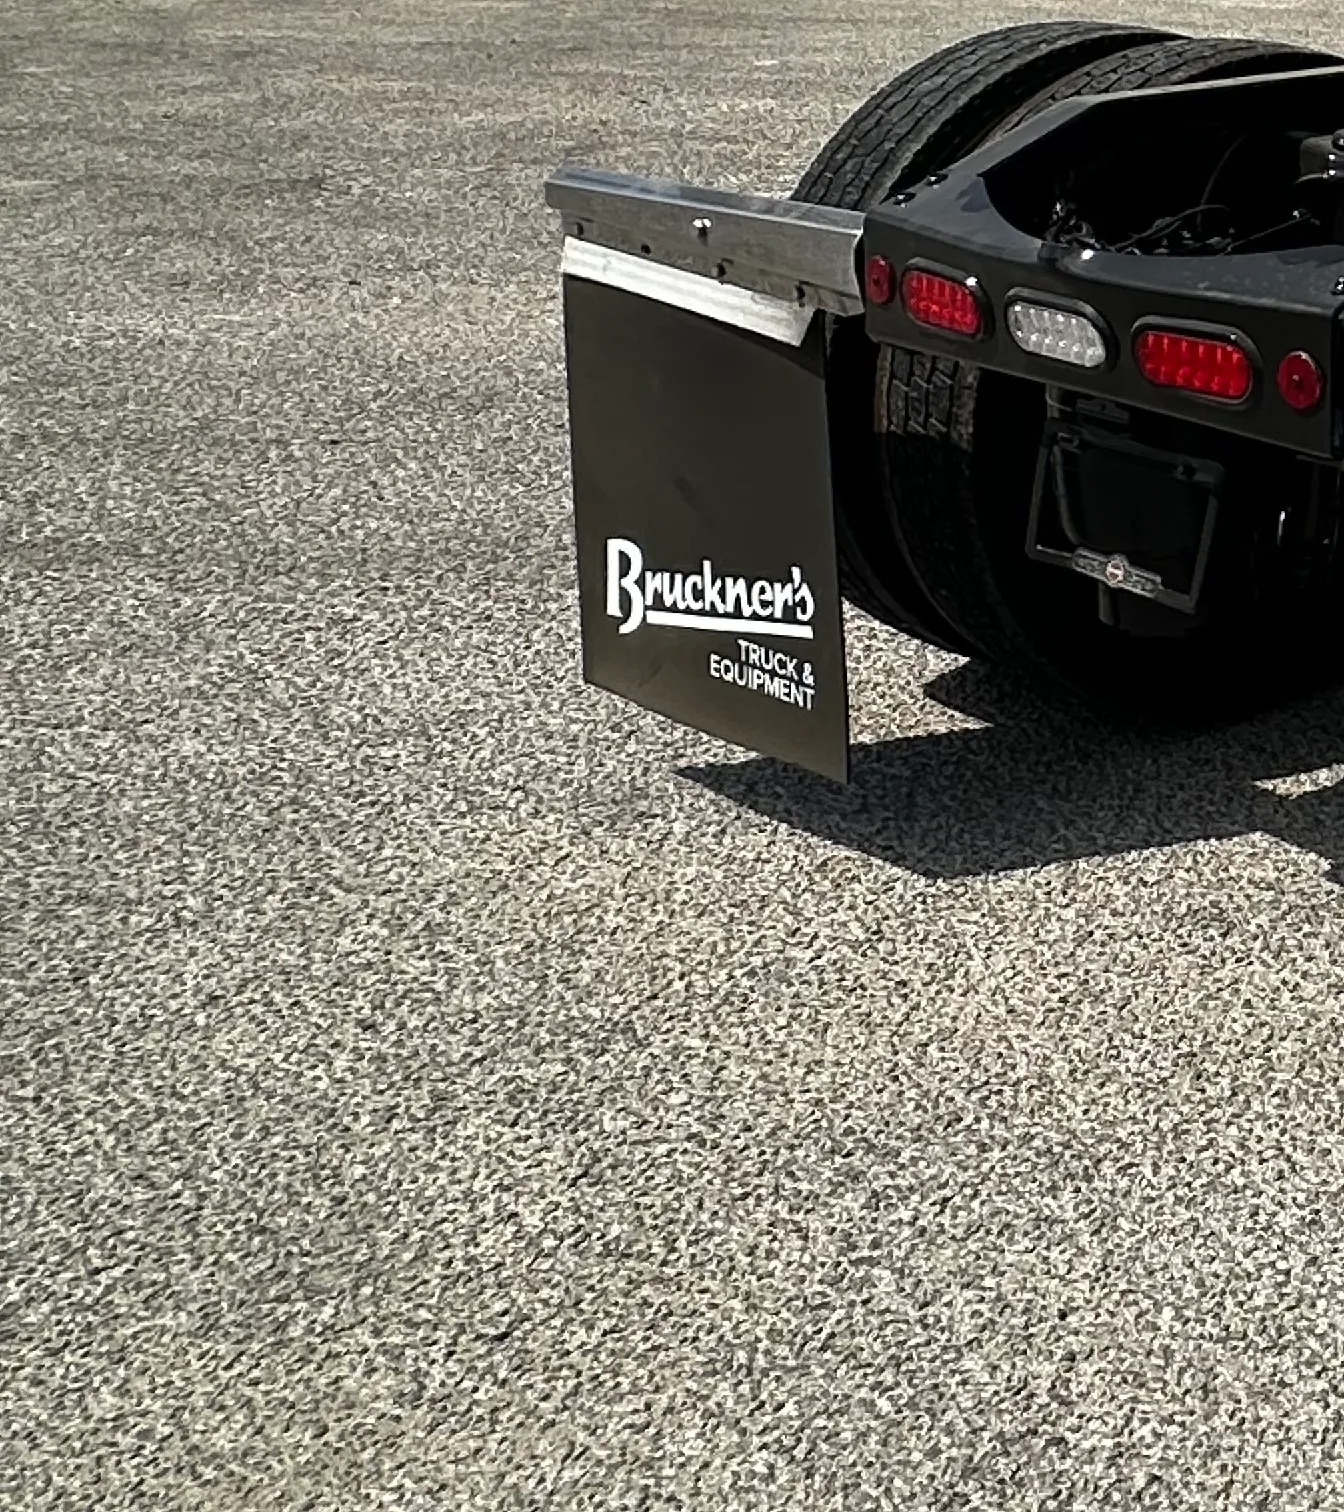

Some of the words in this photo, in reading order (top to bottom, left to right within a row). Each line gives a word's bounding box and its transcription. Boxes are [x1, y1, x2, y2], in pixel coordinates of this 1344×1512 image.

[606, 538, 815, 634] Bruckner's
[709, 653, 816, 710] EQUIPMENT
[737, 639, 800, 680] TRUCK
[803, 662, 816, 686] &
